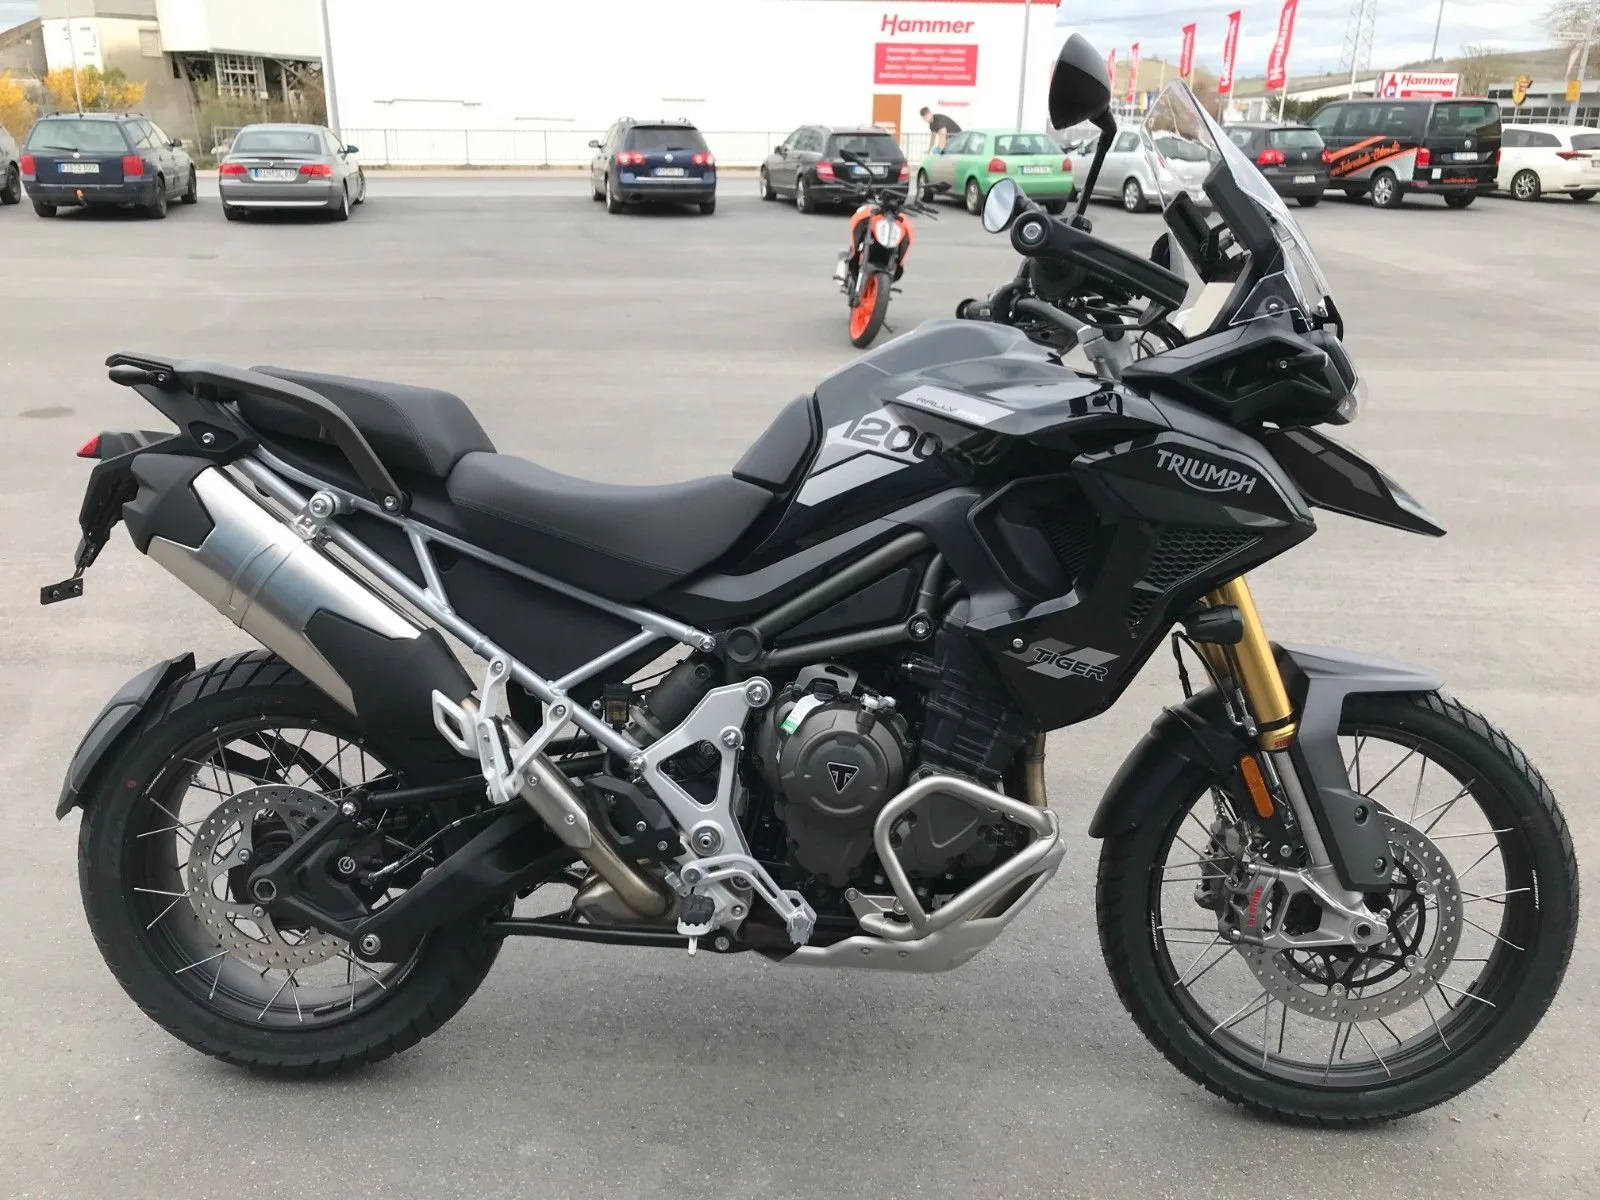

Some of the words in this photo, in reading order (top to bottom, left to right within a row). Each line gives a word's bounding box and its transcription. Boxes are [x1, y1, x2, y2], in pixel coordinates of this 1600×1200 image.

[881, 13, 975, 36] Hammer
[1401, 74, 1456, 87] Hammer
[843, 417, 943, 459] 1200
[1157, 449, 1257, 494] TRIUMPH
[1033, 647, 1108, 681] TIGER
